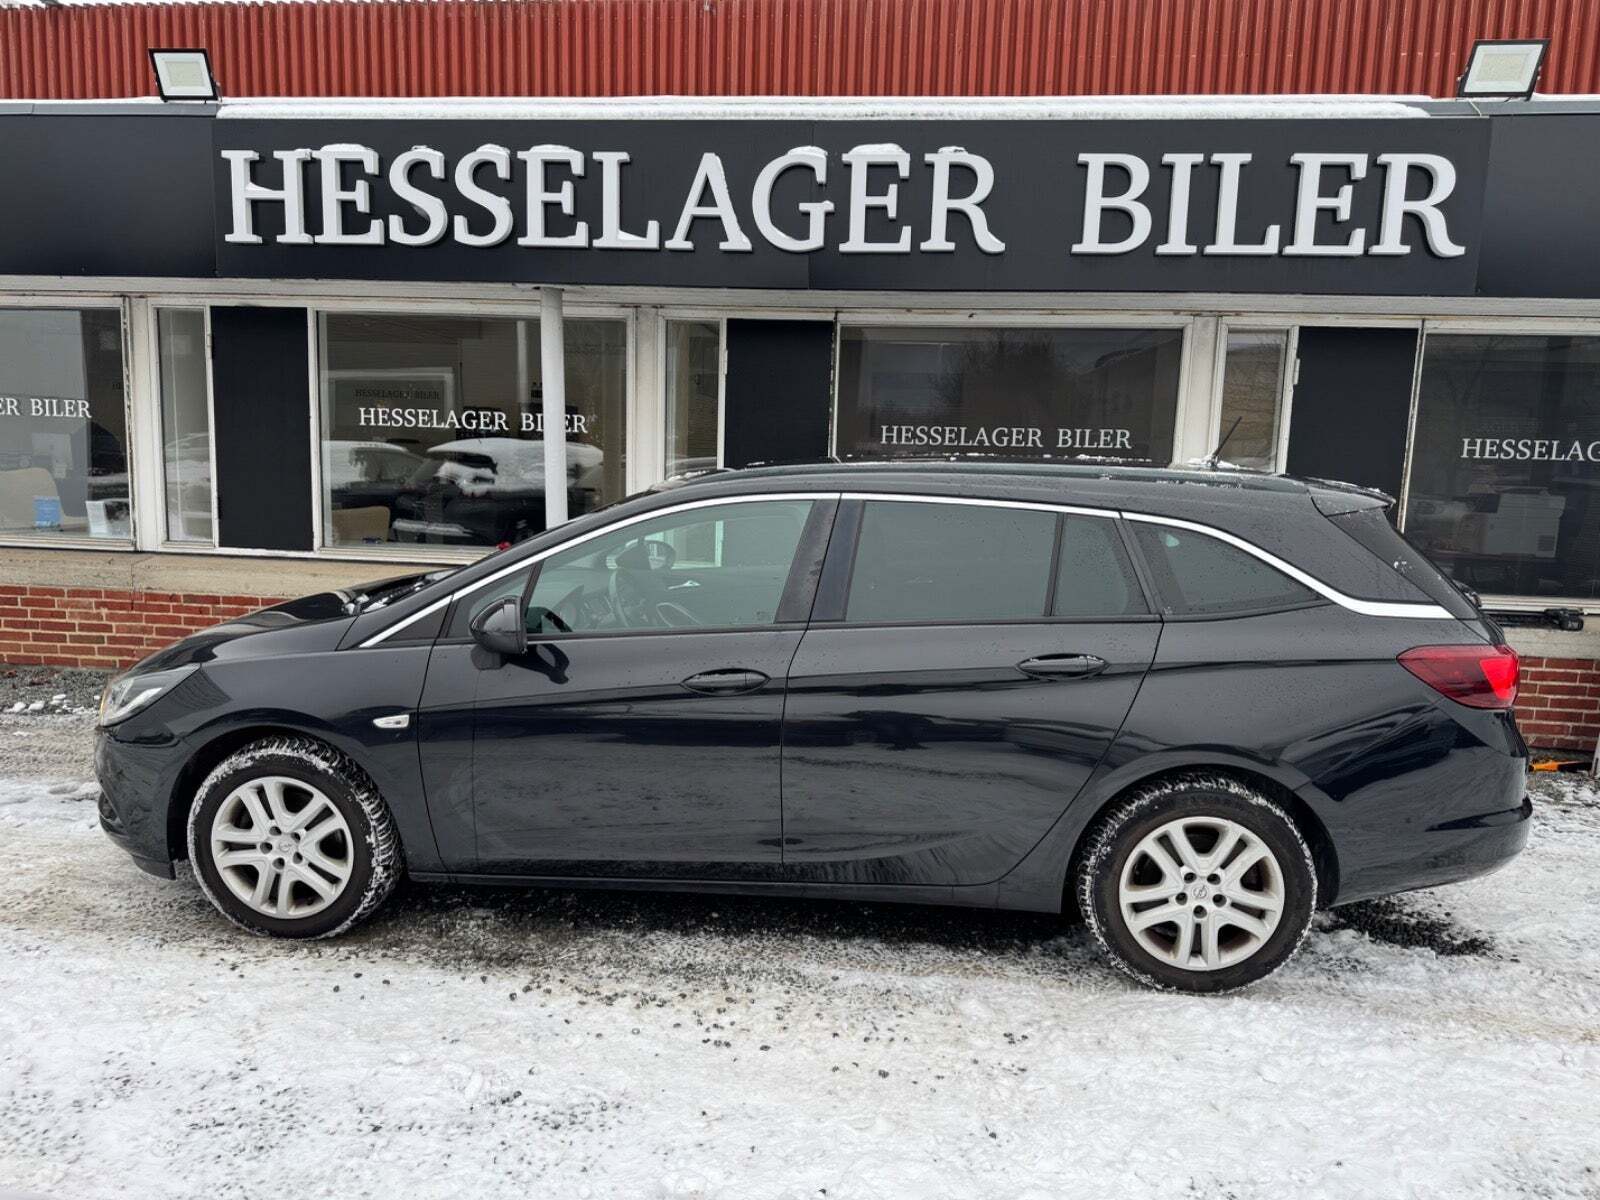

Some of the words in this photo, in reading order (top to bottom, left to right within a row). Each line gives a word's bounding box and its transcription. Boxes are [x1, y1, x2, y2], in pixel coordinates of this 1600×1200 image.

[221, 146, 1006, 256] HESSELAGER
[1071, 152, 1466, 257] BILER
[30, 398, 92, 418] BILER
[359, 407, 510, 431] HESSELAGER
[520, 412, 588, 434] BIER
[880, 425, 1044, 448] HESSELAGER
[1057, 428, 1132, 449] BILER
